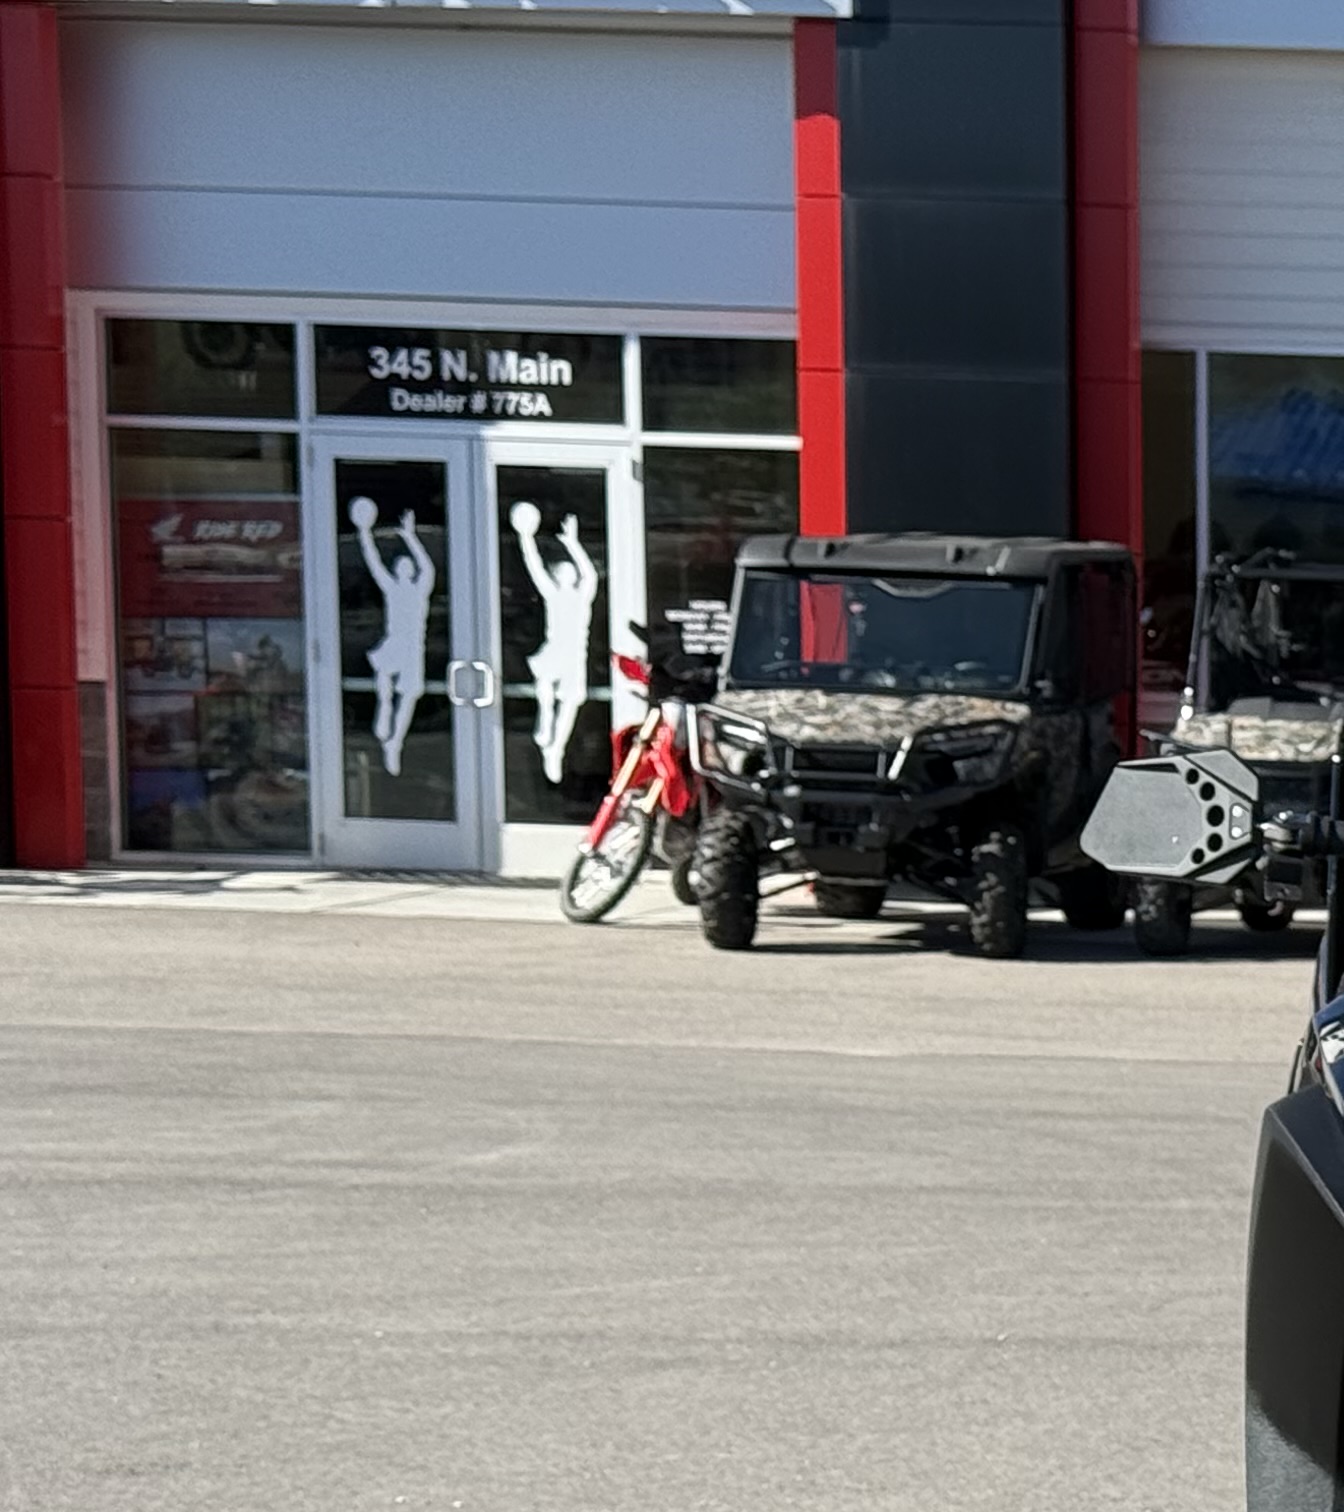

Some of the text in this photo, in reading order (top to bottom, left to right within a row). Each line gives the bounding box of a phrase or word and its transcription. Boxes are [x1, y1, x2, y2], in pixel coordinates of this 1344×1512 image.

[368, 346, 573, 387] 345 N. Main
[388, 387, 467, 413] Dealer
[490, 390, 554, 417] 775A
